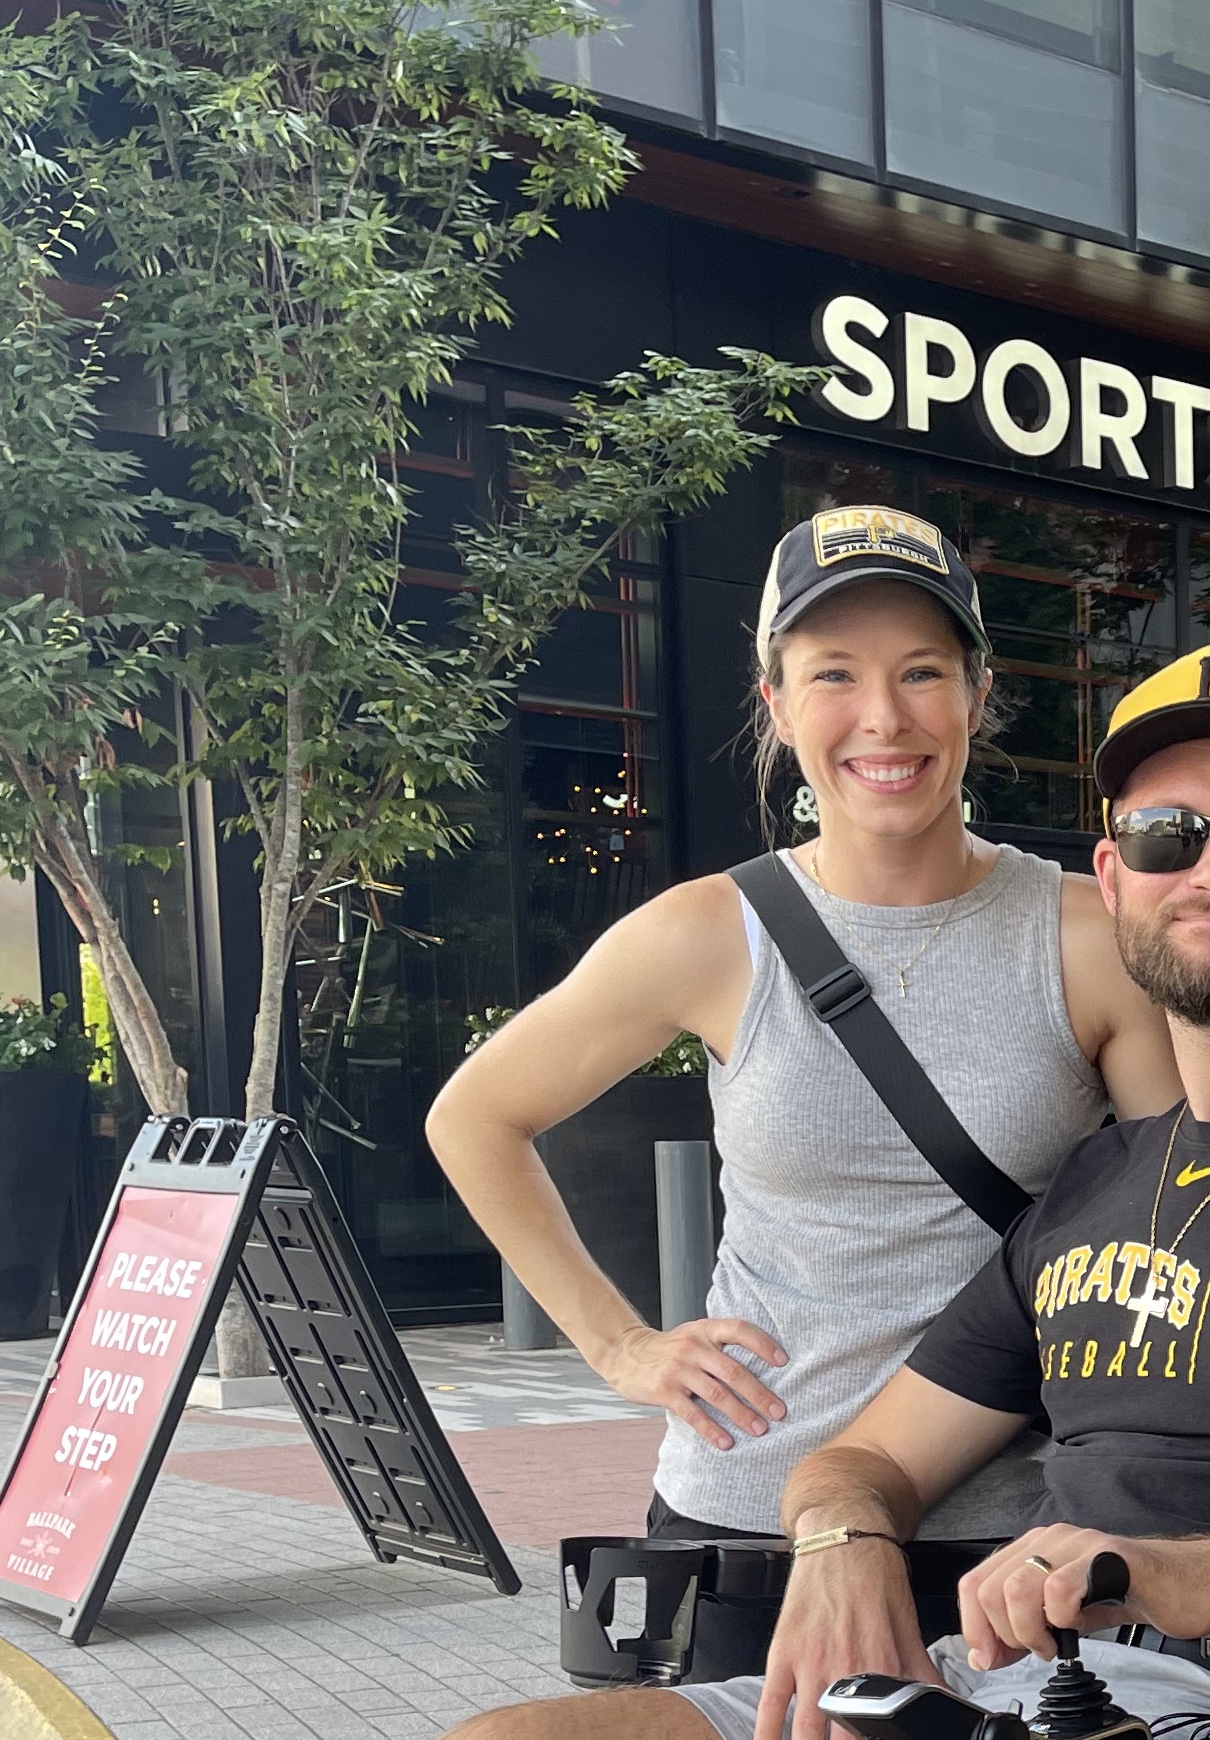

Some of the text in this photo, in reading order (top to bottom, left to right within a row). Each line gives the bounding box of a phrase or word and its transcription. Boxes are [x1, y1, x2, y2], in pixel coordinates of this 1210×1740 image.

[819, 512, 936, 545] PIRATES
[106, 1252, 203, 1299] PLEASE
[1034, 1241, 1201, 1331] PIRATES
[90, 1308, 177, 1358] WATCH
[1042, 1340, 1177, 1381] SEBALL
[76, 1366, 144, 1415] YOUR
[54, 1425, 118, 1472] STEP
[25, 1511, 76, 1540] BALLPARK
[6, 1553, 55, 1582] VILLAGE
